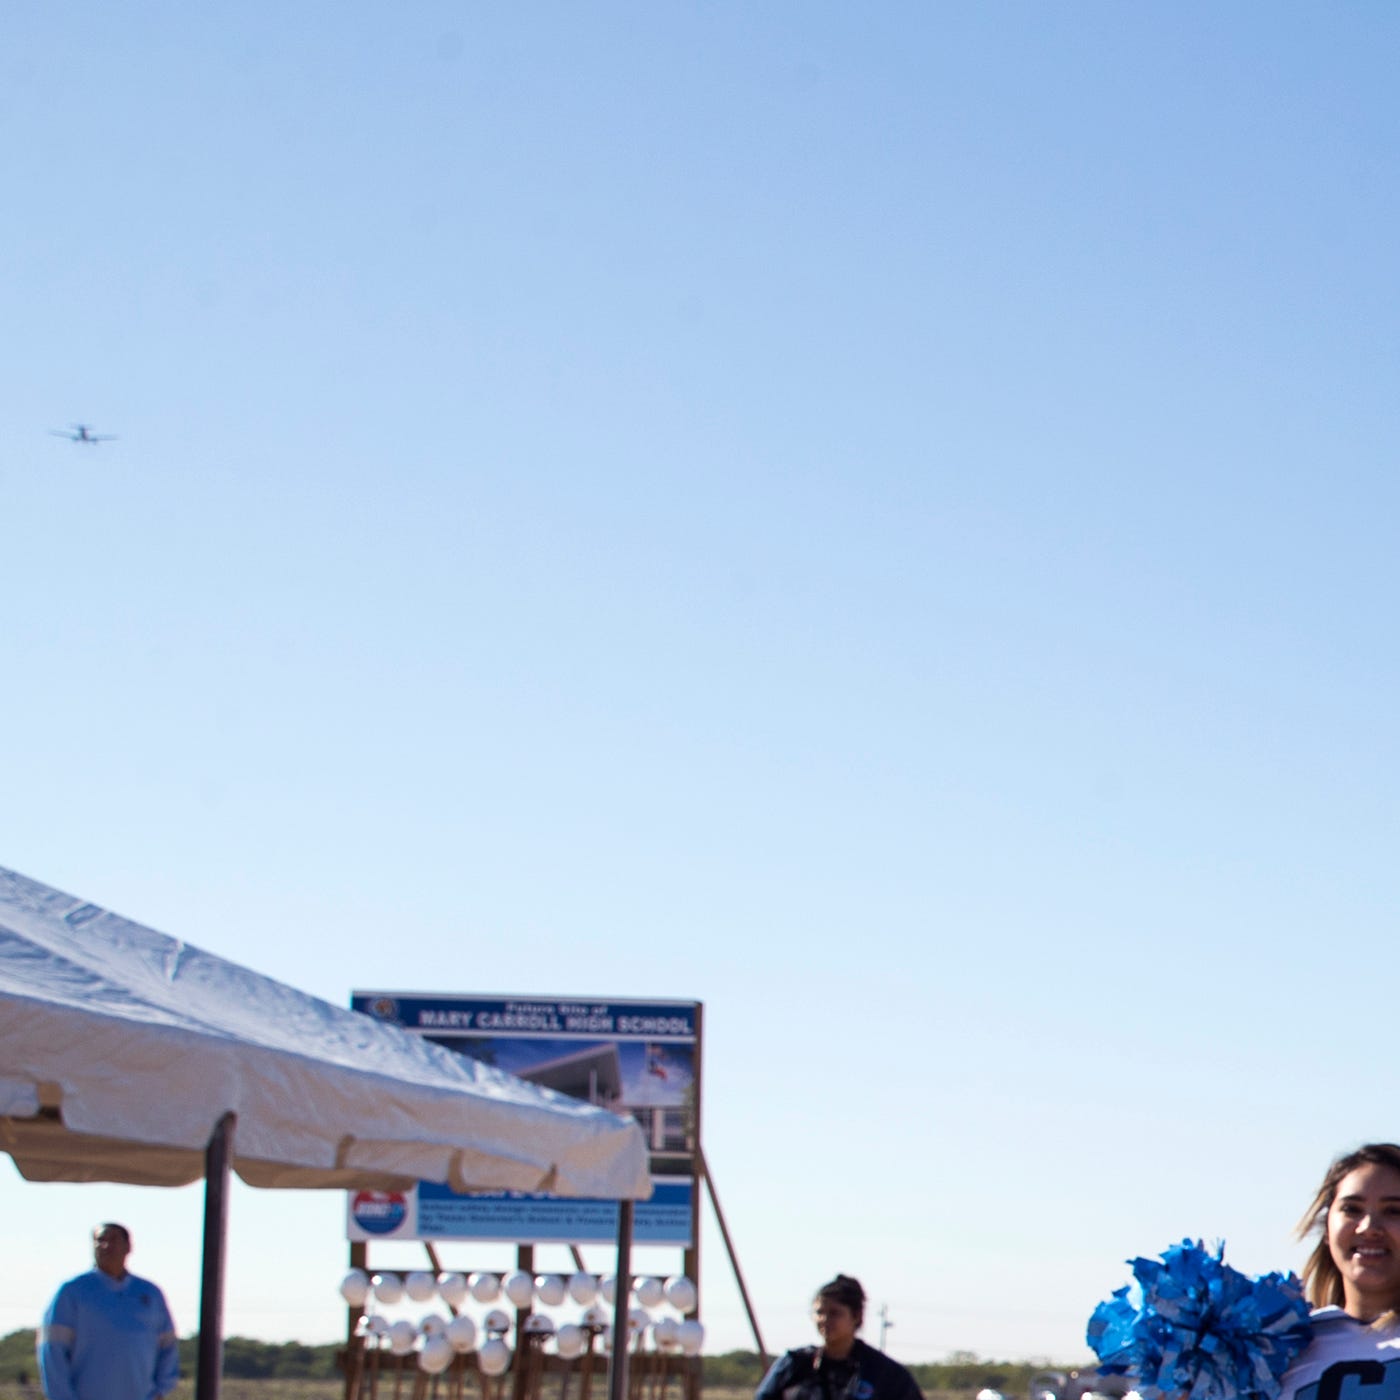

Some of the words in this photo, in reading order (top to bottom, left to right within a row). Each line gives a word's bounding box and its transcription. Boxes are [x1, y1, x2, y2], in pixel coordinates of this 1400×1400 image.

[418, 1010, 472, 1027] MARY
[476, 1011, 562, 1030] CARROLL
[565, 1015, 613, 1032] HIGH
[616, 1016, 693, 1034] SCHOOL
